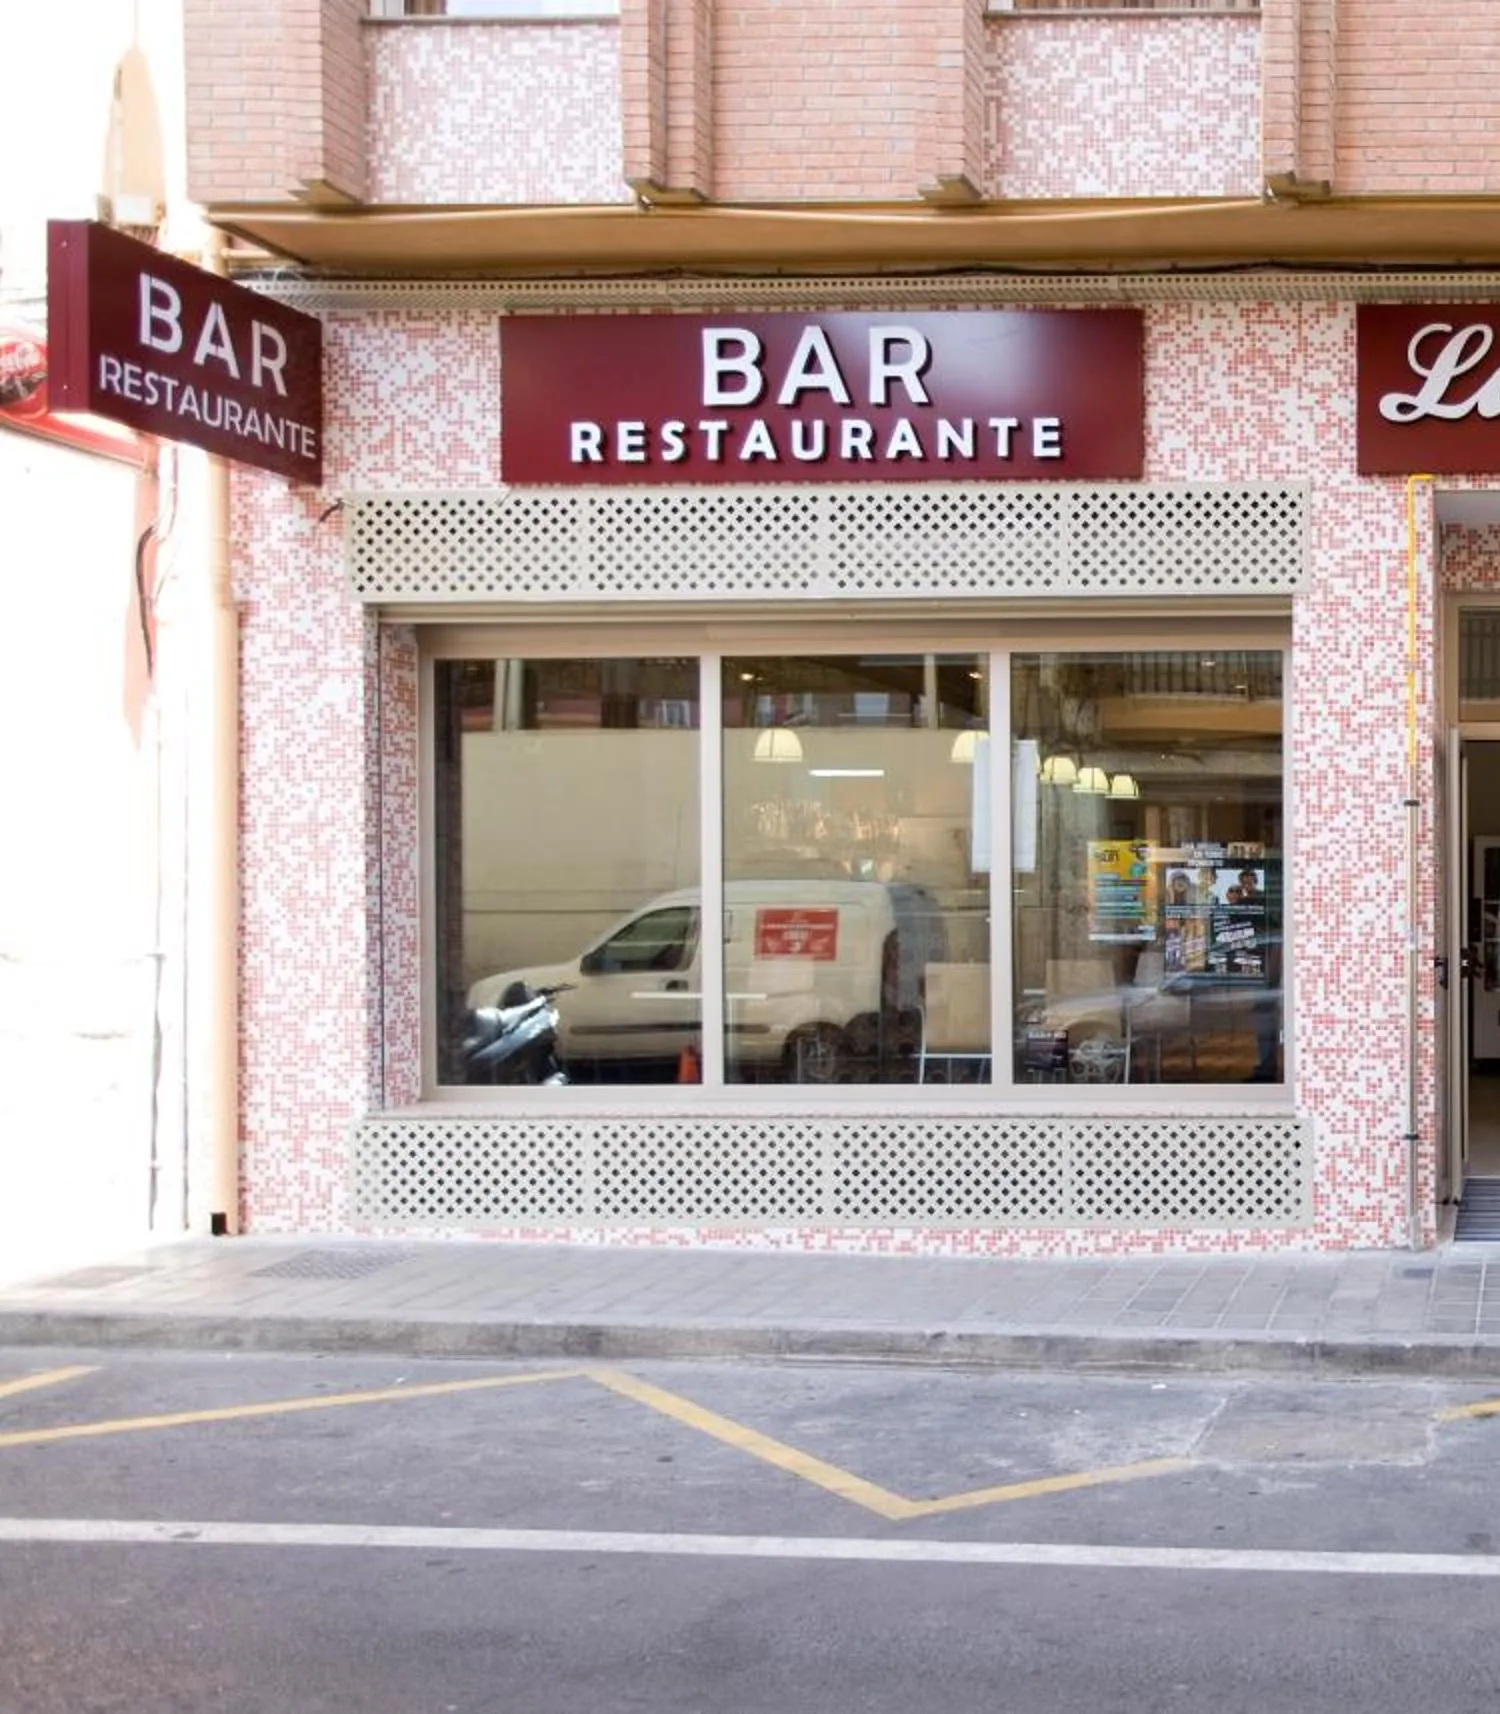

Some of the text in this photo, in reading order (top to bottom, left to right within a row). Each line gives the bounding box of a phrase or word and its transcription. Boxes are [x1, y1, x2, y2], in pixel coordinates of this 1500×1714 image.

[138, 271, 288, 396] BAR
[702, 325, 932, 407] BAR
[99, 354, 317, 460] RESTAURANTE
[570, 417, 1064, 462] RESTAURANTE
